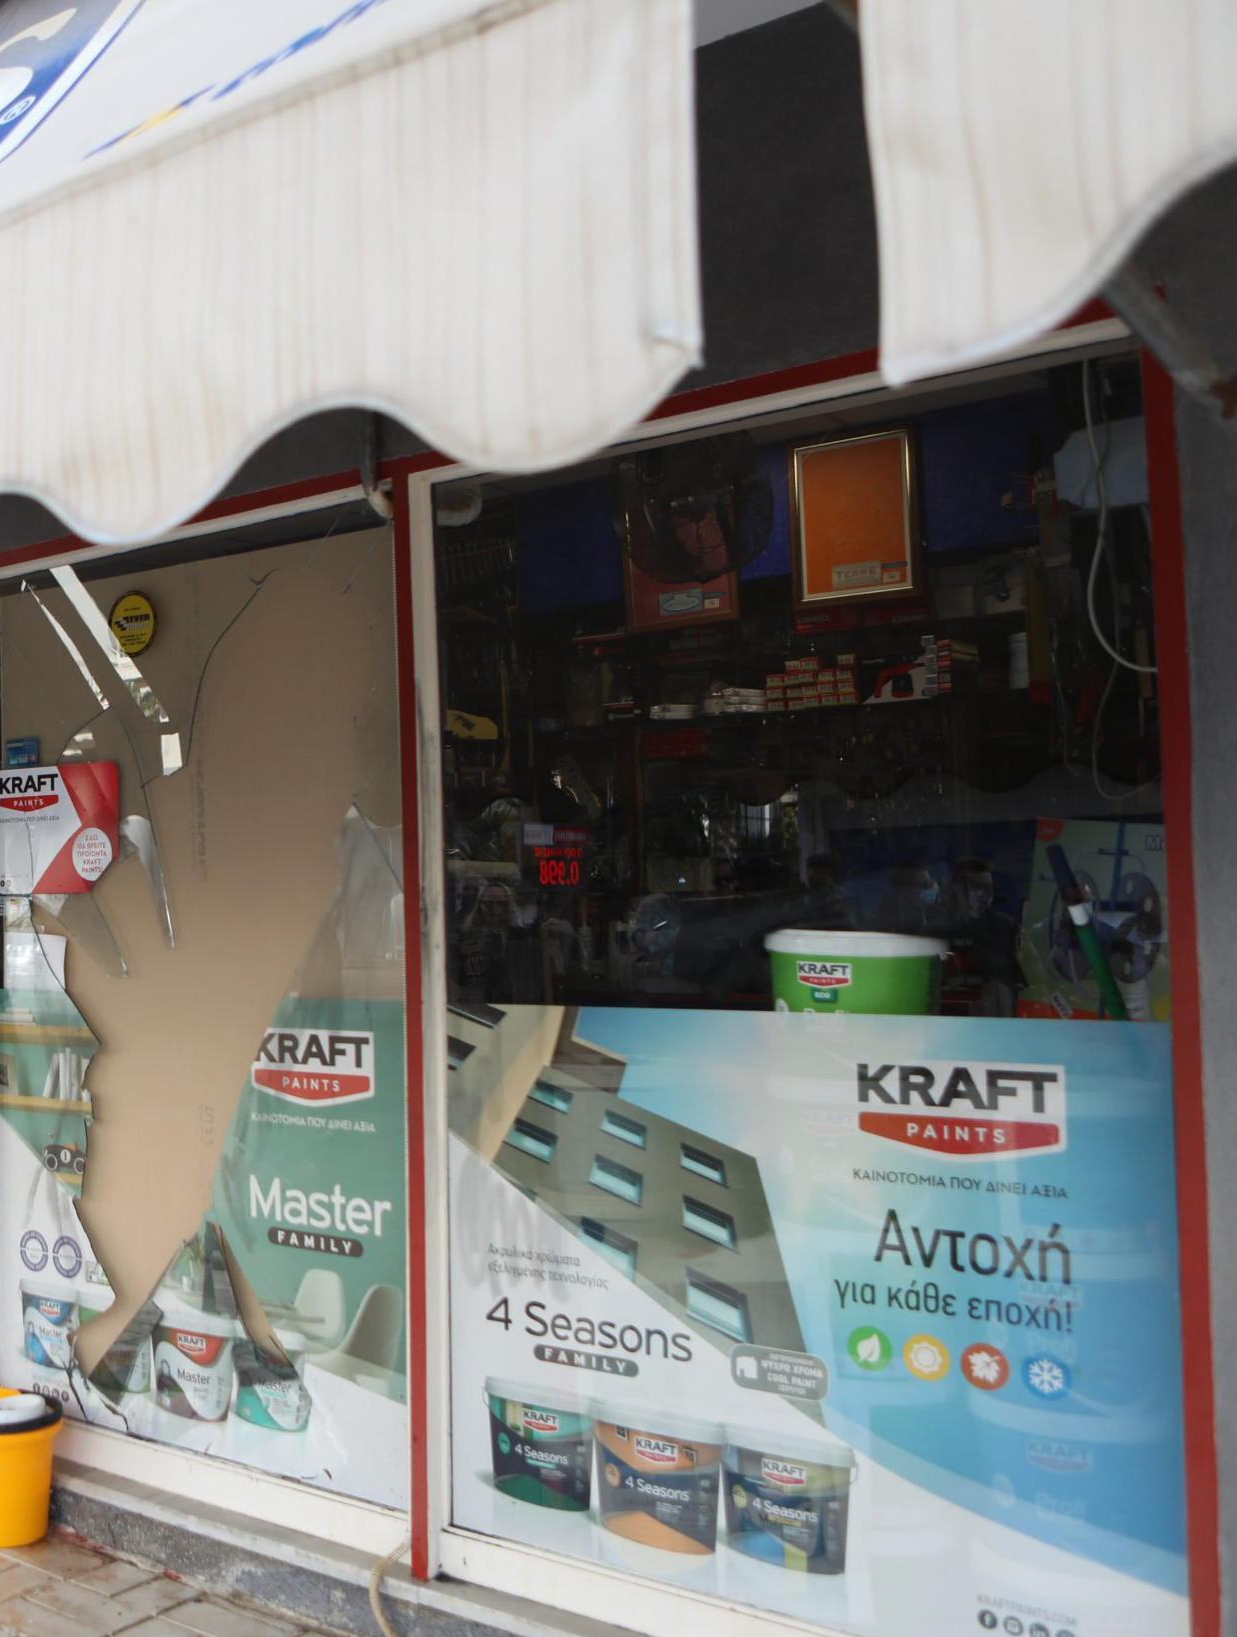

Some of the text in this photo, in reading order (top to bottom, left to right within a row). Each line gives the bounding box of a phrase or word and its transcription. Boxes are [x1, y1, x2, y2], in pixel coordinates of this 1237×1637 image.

[0, 773, 58, 795] KRAFT
[13, 799, 44, 807] PAINTS
[799, 963, 849, 976] KRAFT
[814, 991, 831, 999] ECO
[255, 1033, 369, 1068] KRAFT
[282, 1076, 340, 1092] PAINTS
[857, 1063, 1058, 1113] KRAFT
[307, 1117, 326, 1128] ΠΟΥ
[327, 1119, 352, 1130] ΔΙΝΕΙ
[353, 1121, 375, 1132] ΑΞΙΑ
[907, 1122, 1006, 1144] PAINTS
[853, 1168, 1068, 1199] ΚΑΙΝΟΤΟΜΙΑ ΠΟΥ ΔΙΝΕΙ ΑΞΙΑ
[249, 1173, 392, 1237] Master
[277, 1230, 352, 1254] FAMILY
[874, 1208, 1071, 1286] Αντοχή
[534, 1250, 581, 1268] χρώματα
[487, 1259, 609, 1290] εξελιγμένης τεχνολογίας
[834, 1278, 1074, 1334] για κάθε εποχή!
[39, 1325, 63, 1338] Master
[178, 1334, 205, 1347] KRAFT
[486, 1297, 693, 1362] 4 Seasons
[544, 1348, 628, 1373] FAMILY
[177, 1367, 210, 1386] Master
[767, 1372, 816, 1390] COOL PAINT
[523, 1410, 558, 1425] KRAFT
[514, 1443, 568, 1465] 4 Seasons
[635, 1437, 676, 1454] KRAFT
[763, 1460, 805, 1478] KRAFT
[625, 1476, 689, 1501] 4 Seasons
[752, 1498, 818, 1522] 4 Seasons
